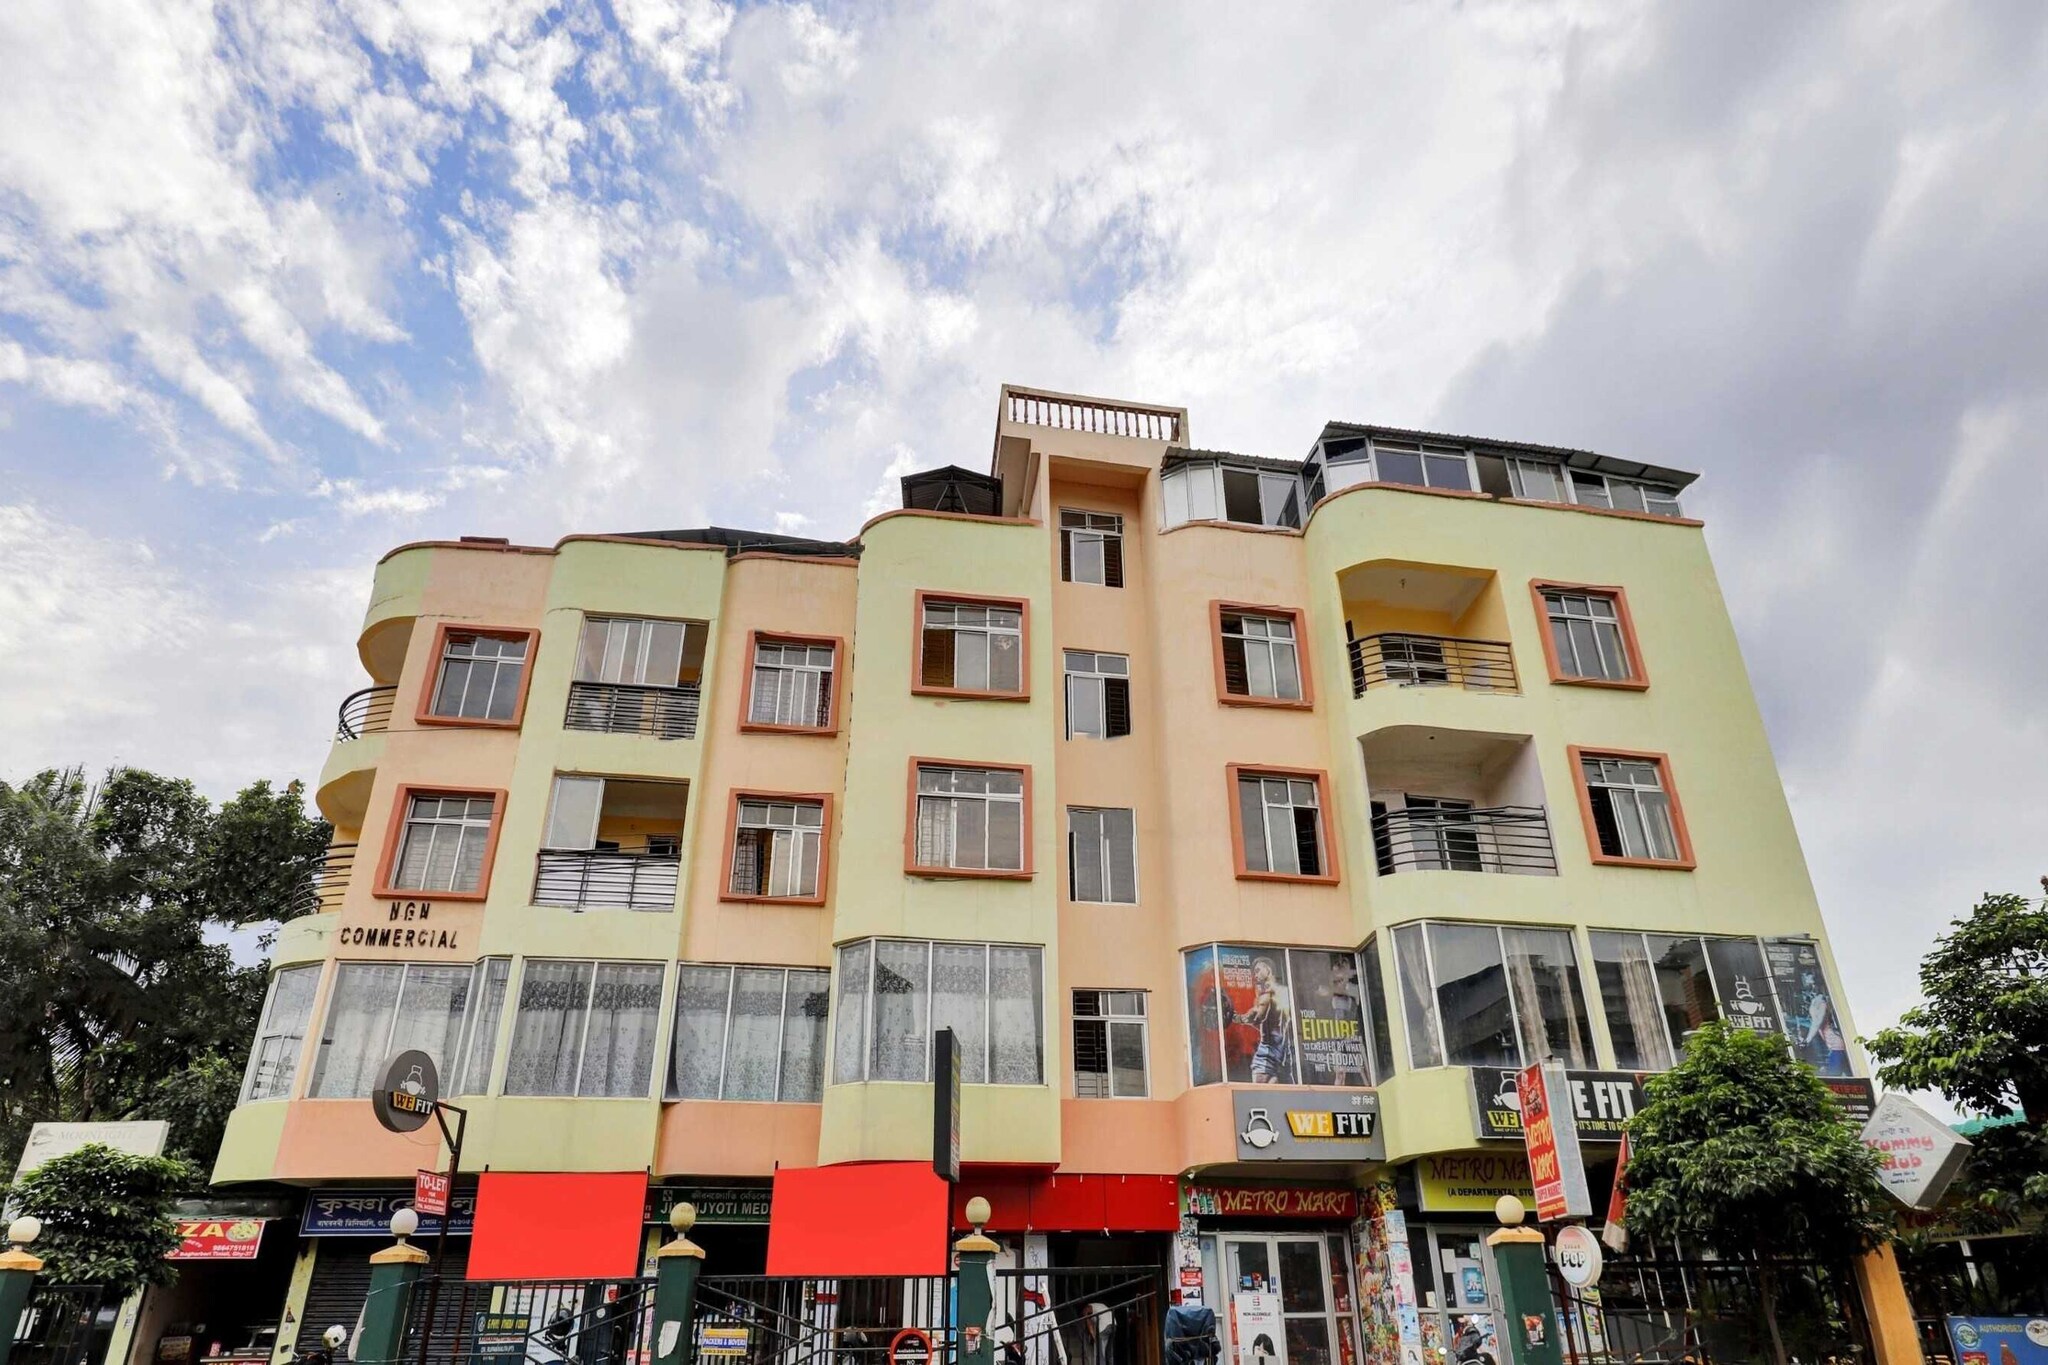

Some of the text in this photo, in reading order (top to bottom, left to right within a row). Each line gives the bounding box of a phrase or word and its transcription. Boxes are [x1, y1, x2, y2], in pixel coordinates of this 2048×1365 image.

[389, 901, 430, 921] NGN
[340, 927, 458, 949] COMMERCIAL
[1301, 1009, 1316, 1018] YOUR
[1753, 1016, 1772, 1028] FIT
[1311, 1041, 1335, 1052] CREATED
[1345, 1042, 1361, 1052] WHAT
[394, 1092, 434, 1115] WE FIT
[1567, 1080, 1635, 1119] E FIT
[1293, 1112, 1372, 1135] WE FIT
[1490, 1111, 1517, 1126] WE
[1578, 1120, 1590, 1131] IT'S
[1606, 1120, 1616, 1131] TO
[1526, 1116, 1552, 1149] METRO
[1428, 1156, 1530, 1183] METRO MA
[1533, 1150, 1555, 1181] MART
[420, 1174, 447, 1192] TO-LET
[1447, 1187, 1534, 1198] (A DEPARTMENTAL STO
[661, 1202, 738, 1215] JINJYOTI
[741, 1202, 772, 1215] MED
[1223, 1190, 1351, 1215] METRO MART
[1561, 1250, 1585, 1268] POP
